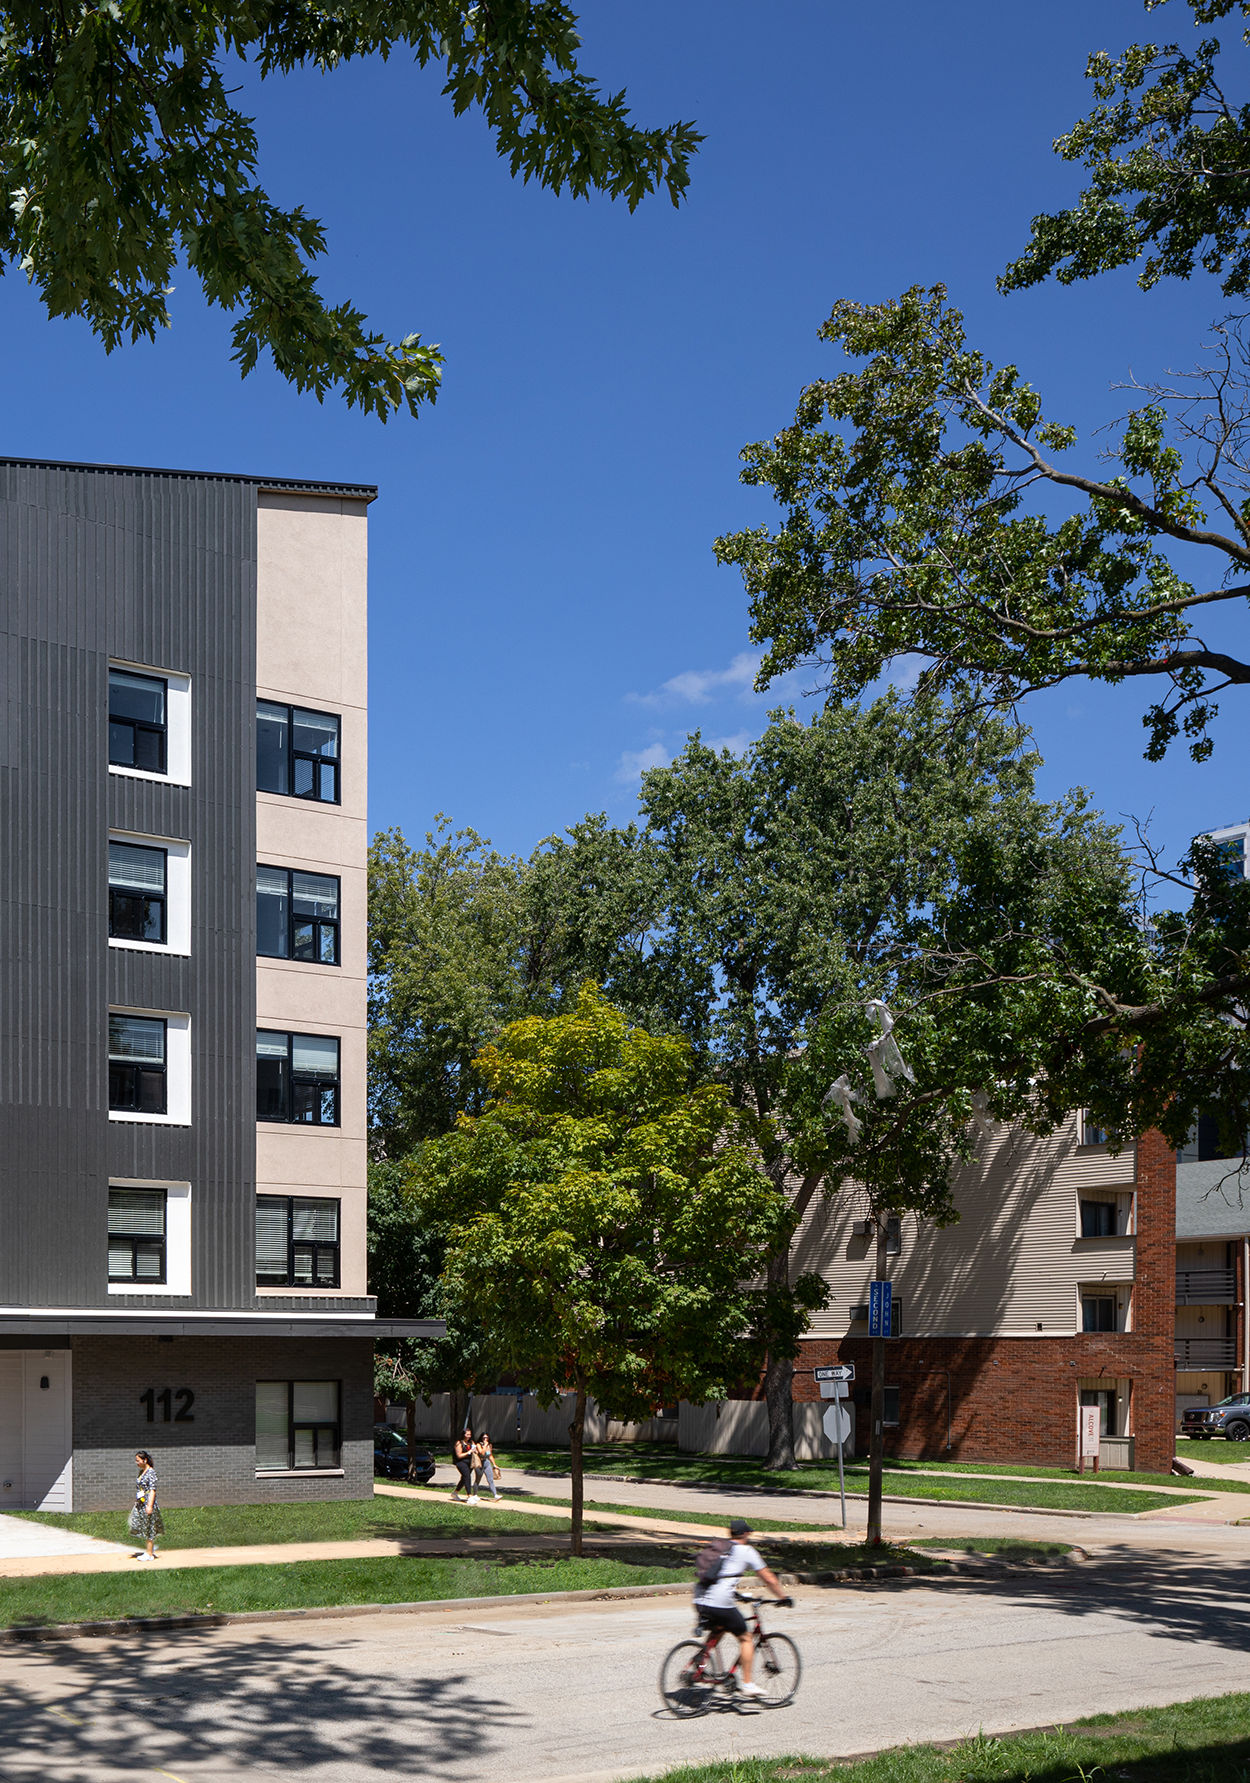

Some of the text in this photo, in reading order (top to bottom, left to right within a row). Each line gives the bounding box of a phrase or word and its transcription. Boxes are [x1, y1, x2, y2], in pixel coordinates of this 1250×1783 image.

[818, 1369, 843, 1378] ONE WAY
[139, 1388, 195, 1423] 112
[1087, 1414, 1095, 1437] ALCOVE
